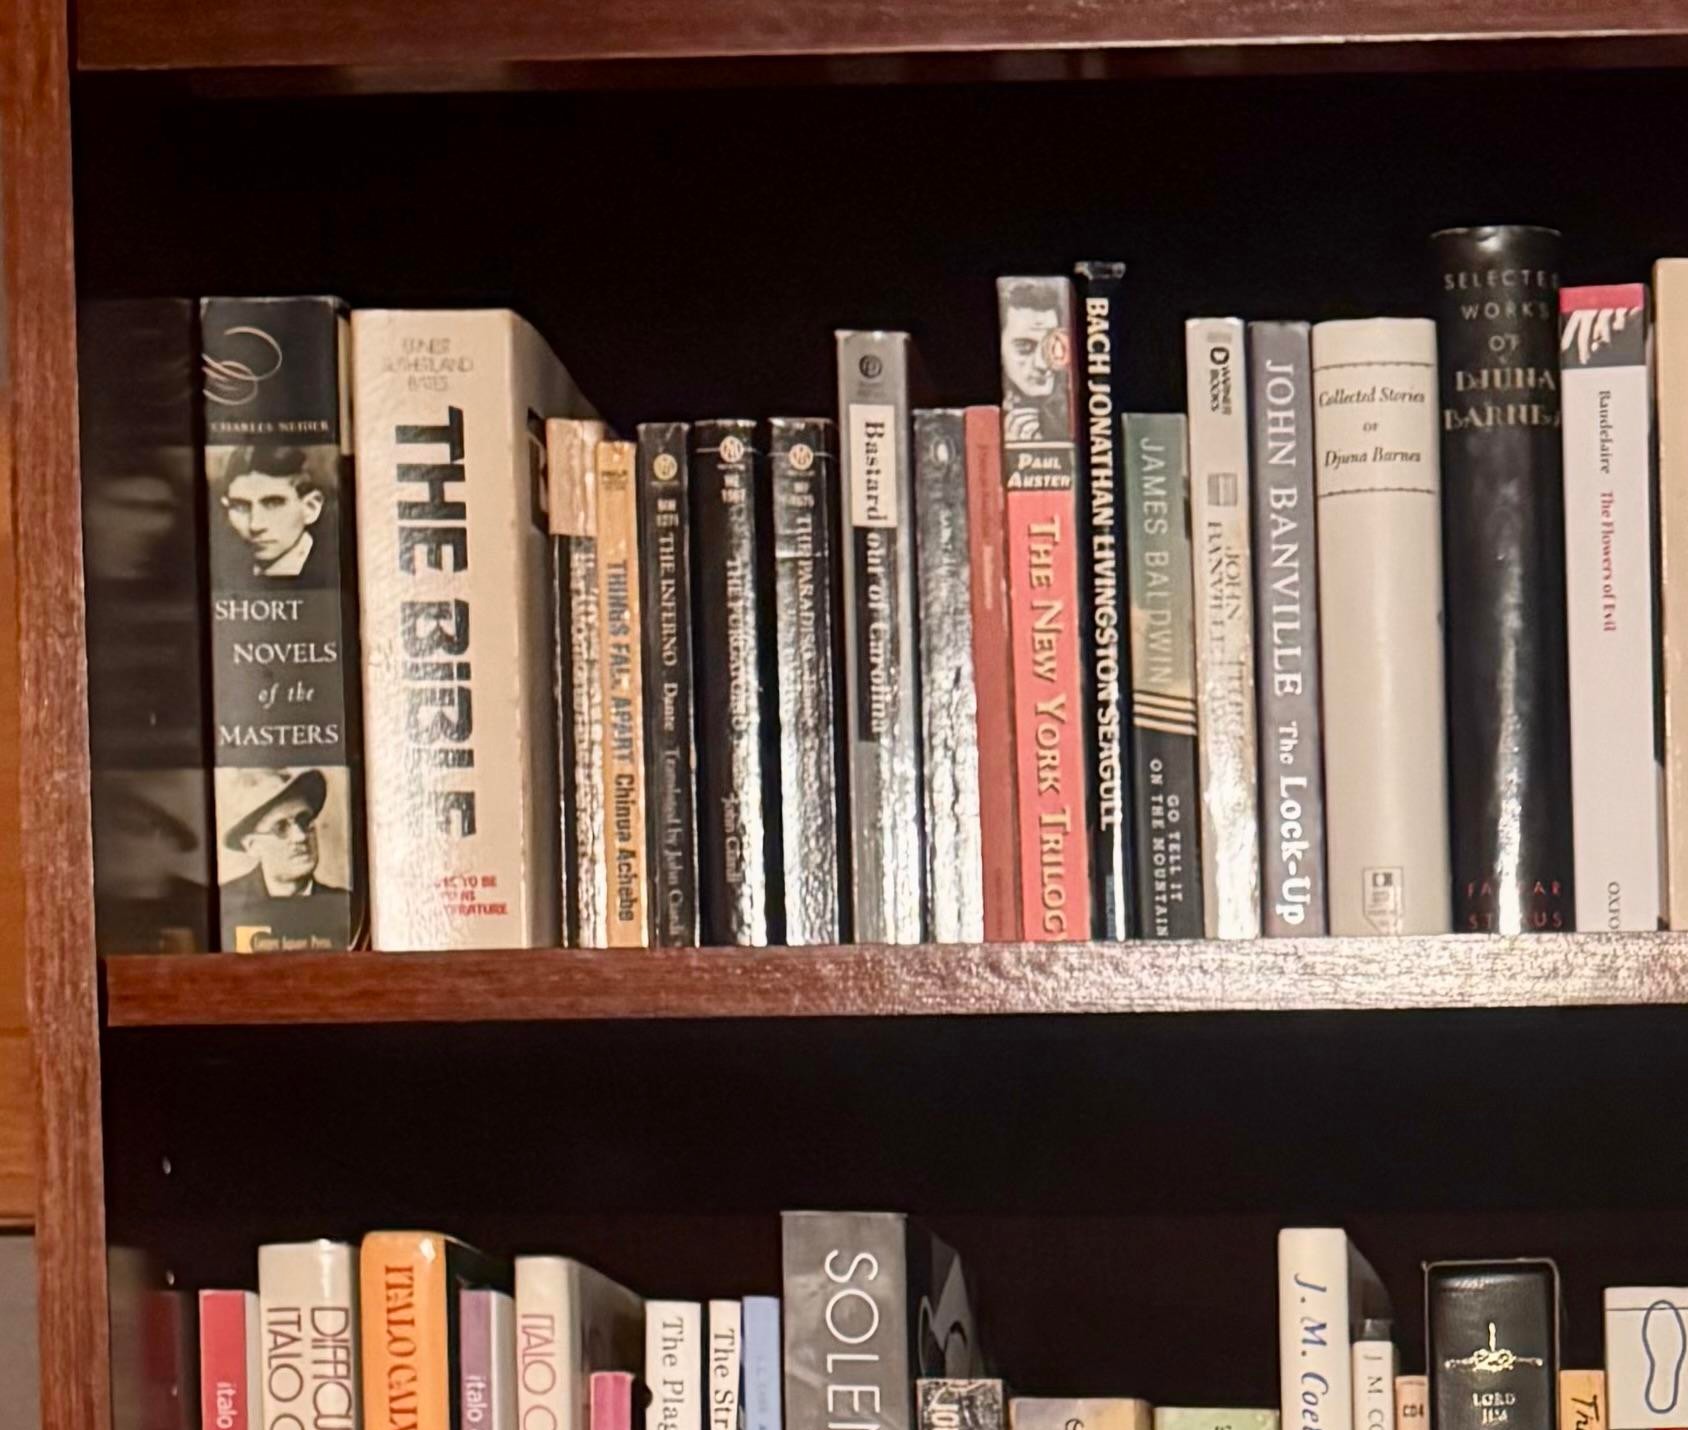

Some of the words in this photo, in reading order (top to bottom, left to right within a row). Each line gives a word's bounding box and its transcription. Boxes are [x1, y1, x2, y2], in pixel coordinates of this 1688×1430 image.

[1266, 360, 1295, 467] JOHN
[216, 600, 302, 621] SHORT
[1273, 487, 1302, 696] BANVILLE
[233, 642, 337, 664] NOVELS
[259, 682, 278, 709] of
[288, 682, 315, 703] the
[218, 723, 339, 745] MASTERS
[1279, 722, 1298, 765] The
[1277, 776, 1305, 925] Lock-Up
[267, 1307, 306, 1403] ITALO
[662, 1318, 684, 1366] The
